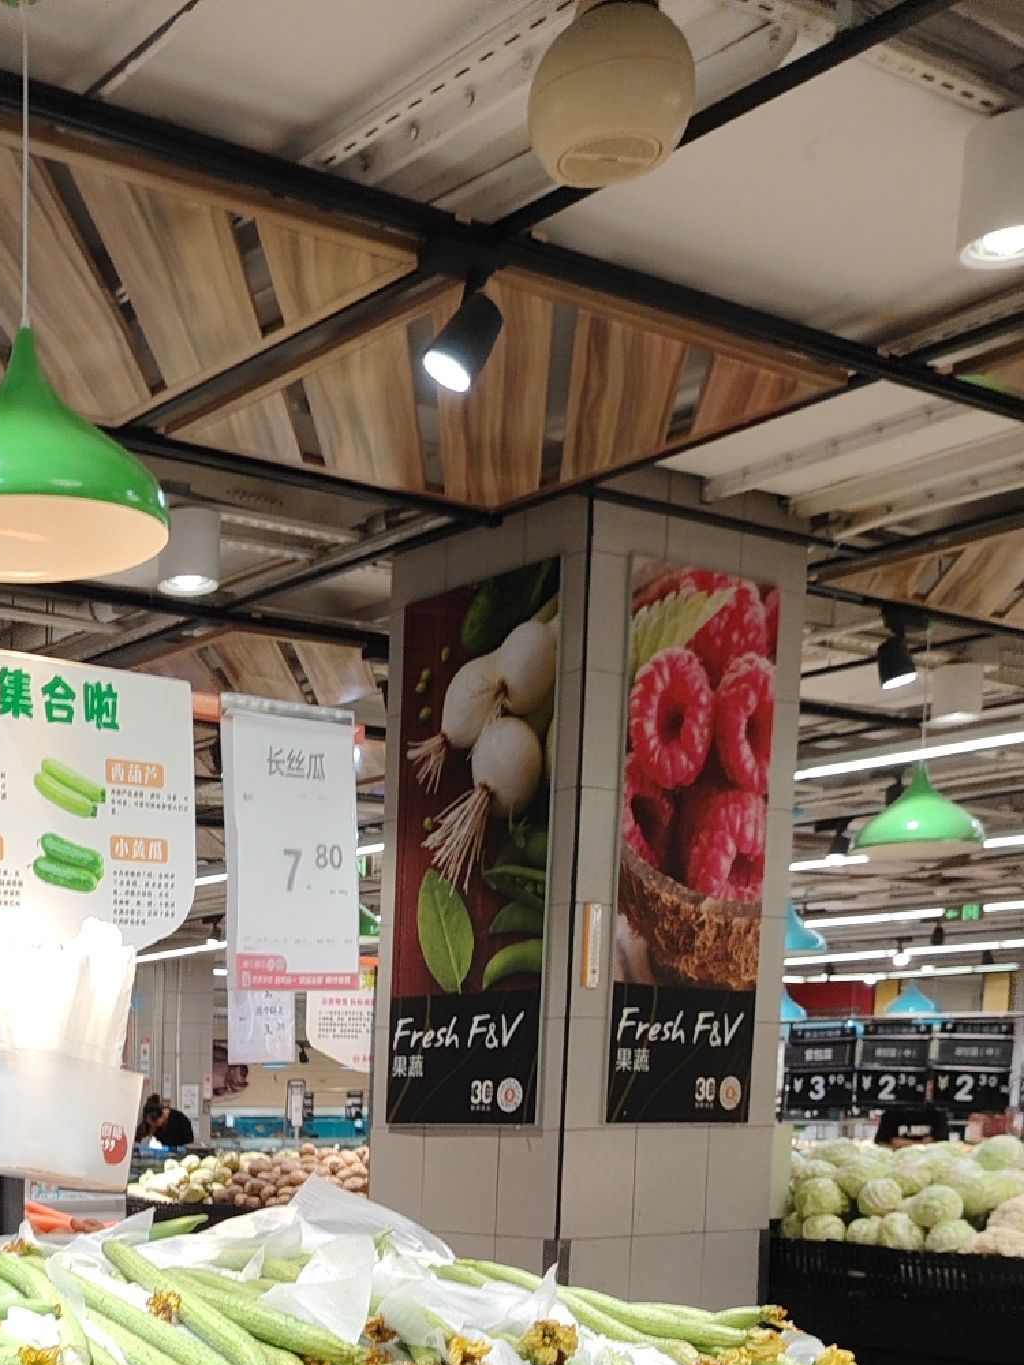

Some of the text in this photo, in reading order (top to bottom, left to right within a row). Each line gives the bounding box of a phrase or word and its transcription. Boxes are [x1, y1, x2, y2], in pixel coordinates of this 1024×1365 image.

[266, 744, 326, 782] 长丝瓜
[115, 837, 162, 860] 小黄瓜
[392, 1015, 460, 1052] Fresh
[466, 1010, 525, 1049] F&V
[616, 1006, 745, 1047] Fresh F&V
[391, 1054, 424, 1079] 果蔬
[615, 1047, 651, 1074] 果蔬
